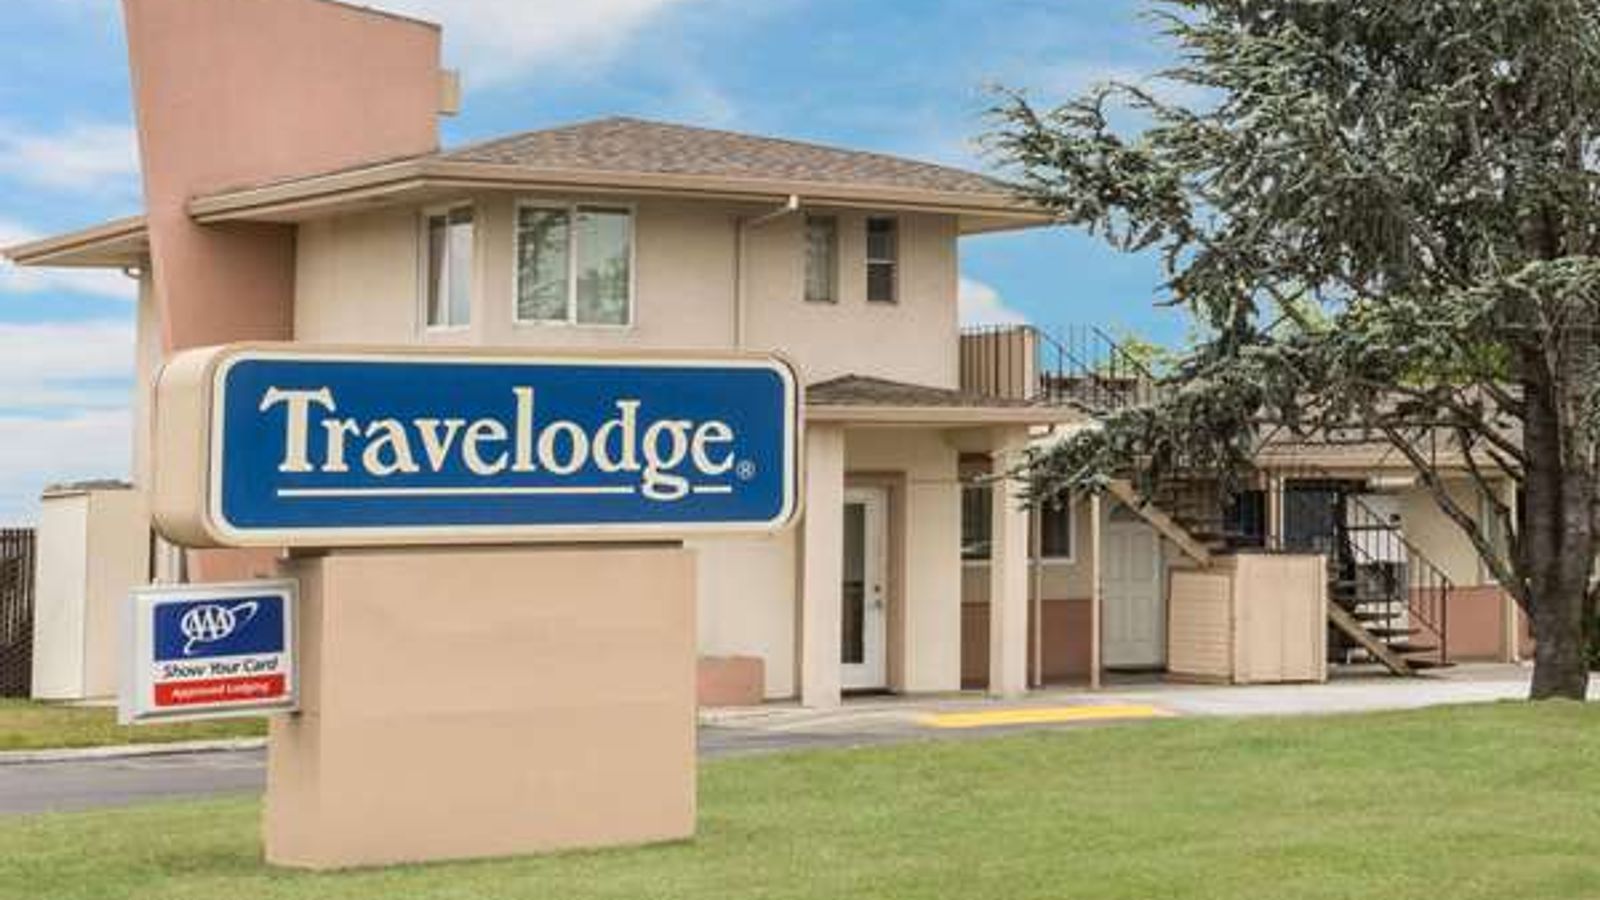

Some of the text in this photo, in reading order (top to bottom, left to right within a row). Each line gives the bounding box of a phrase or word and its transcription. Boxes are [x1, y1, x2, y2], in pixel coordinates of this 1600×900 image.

[259, 386, 735, 500] Travelodge
[187, 607, 230, 640] AAA
[163, 656, 279, 678] Show Your Card
